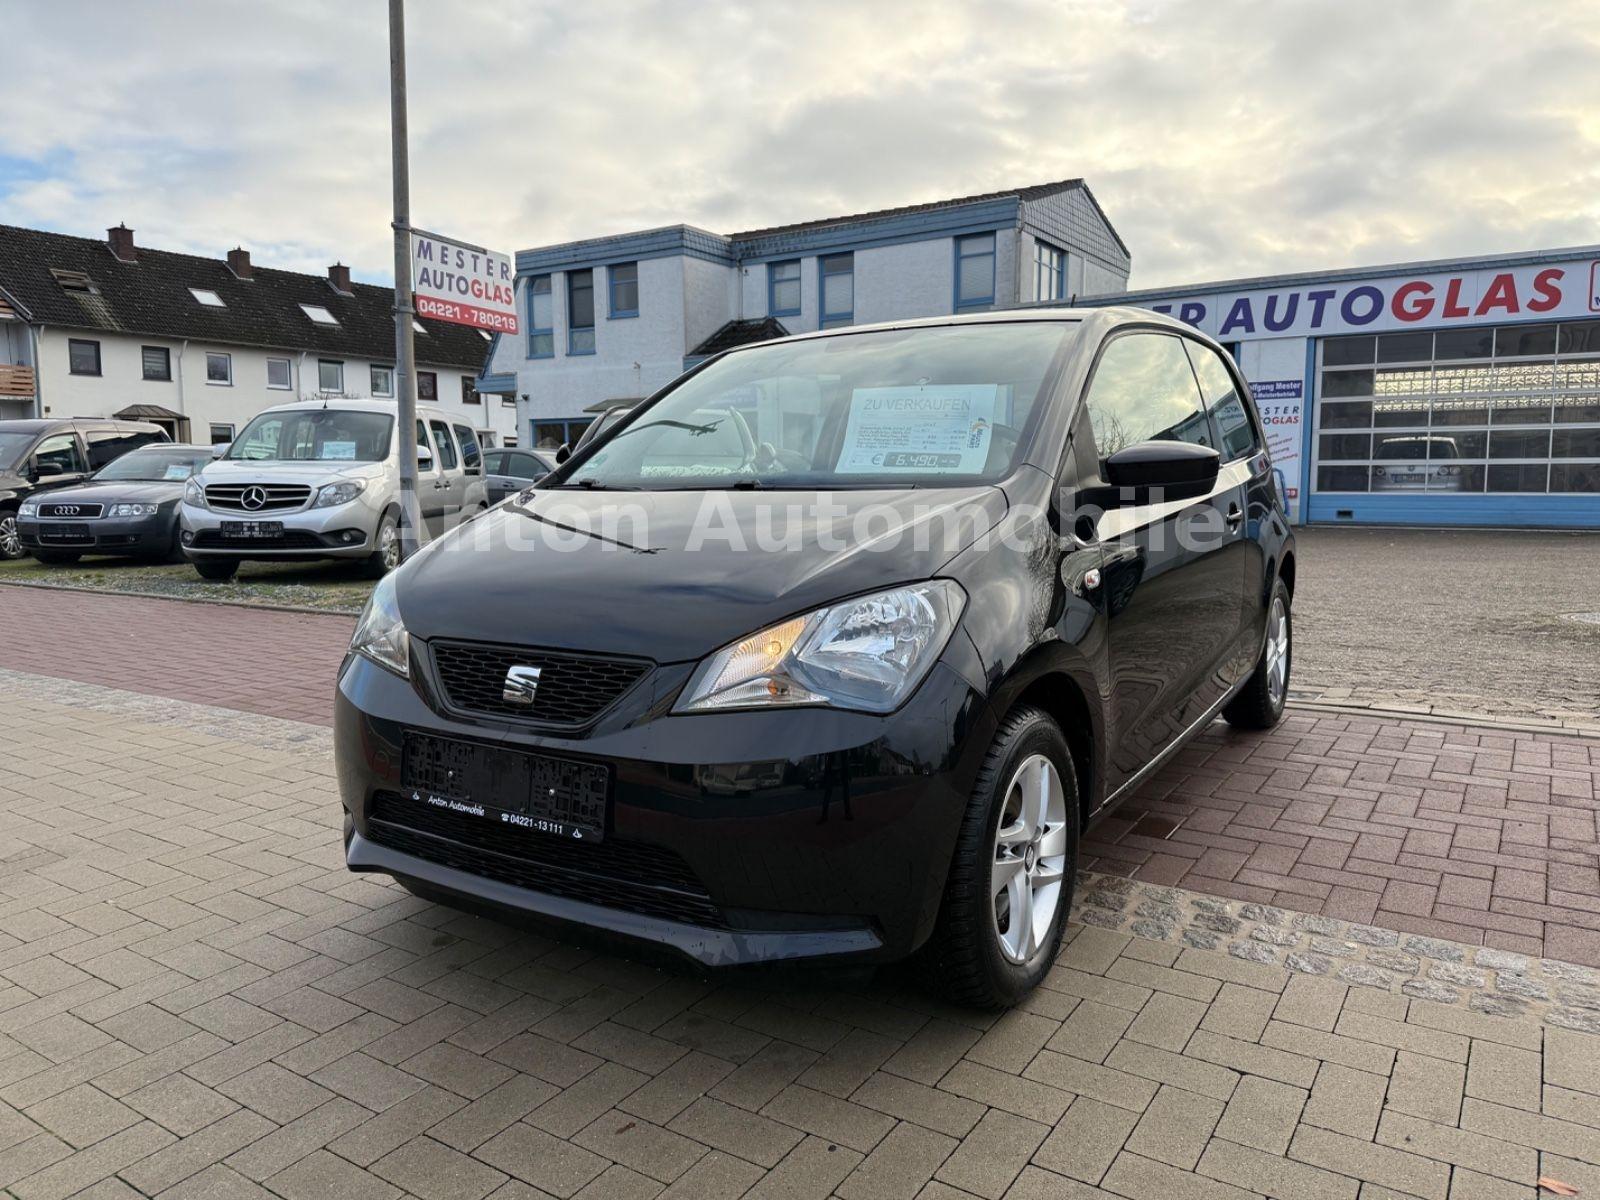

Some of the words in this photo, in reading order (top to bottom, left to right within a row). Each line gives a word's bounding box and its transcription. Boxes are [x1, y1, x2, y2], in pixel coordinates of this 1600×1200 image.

[417, 240, 510, 281] MESTER
[419, 267, 513, 306] AUTOGLAS
[1219, 268, 1565, 336] AUTOGLAS
[420, 299, 461, 319] 04221
[470, 309, 516, 330] 780219
[863, 399, 882, 411] ZU
[886, 398, 969, 411] VERKAUFEN
[1264, 406, 1300, 415] STER
[1263, 416, 1299, 425] OGLAS
[428, 795, 448, 807] Anton
